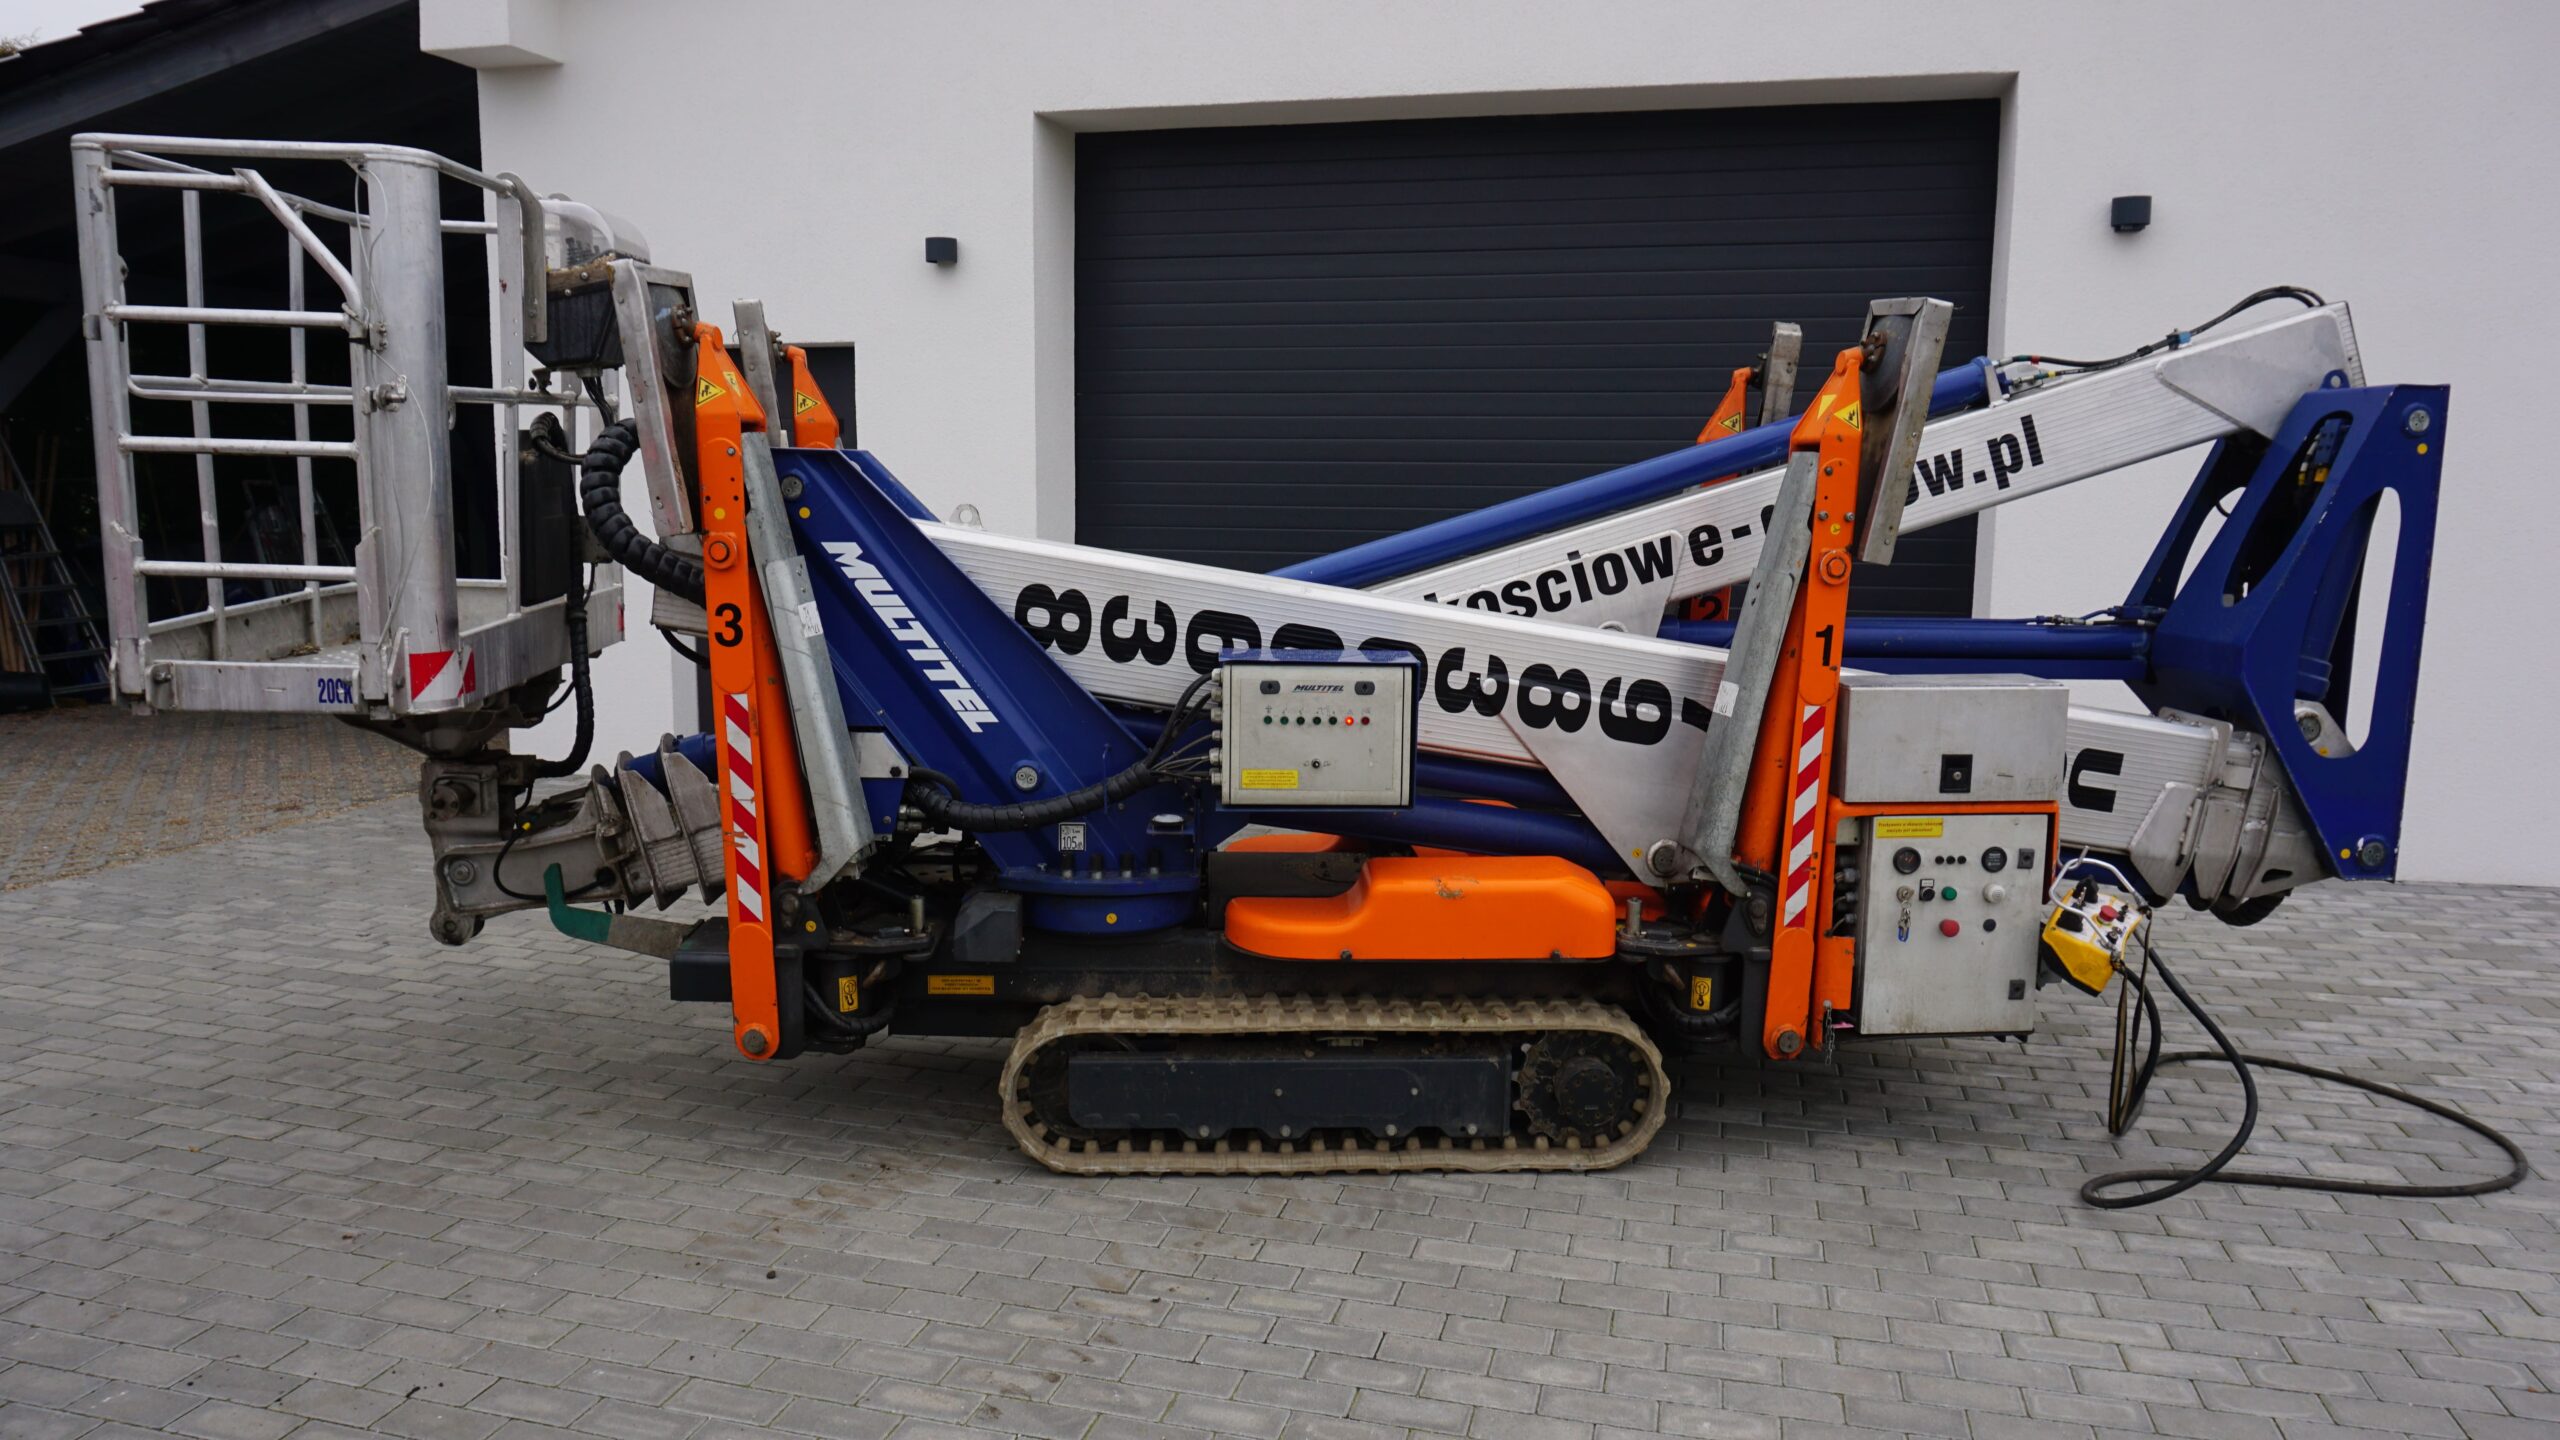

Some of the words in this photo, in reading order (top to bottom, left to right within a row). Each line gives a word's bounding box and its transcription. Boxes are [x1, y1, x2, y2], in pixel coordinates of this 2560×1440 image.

[714, 602, 744, 648] 3
[1698, 595, 1722, 620] 2
[820, 541, 1000, 733] MULTITEL
[1815, 624, 1834, 666] 1
[1293, 684, 1345, 692] MULTITEL
